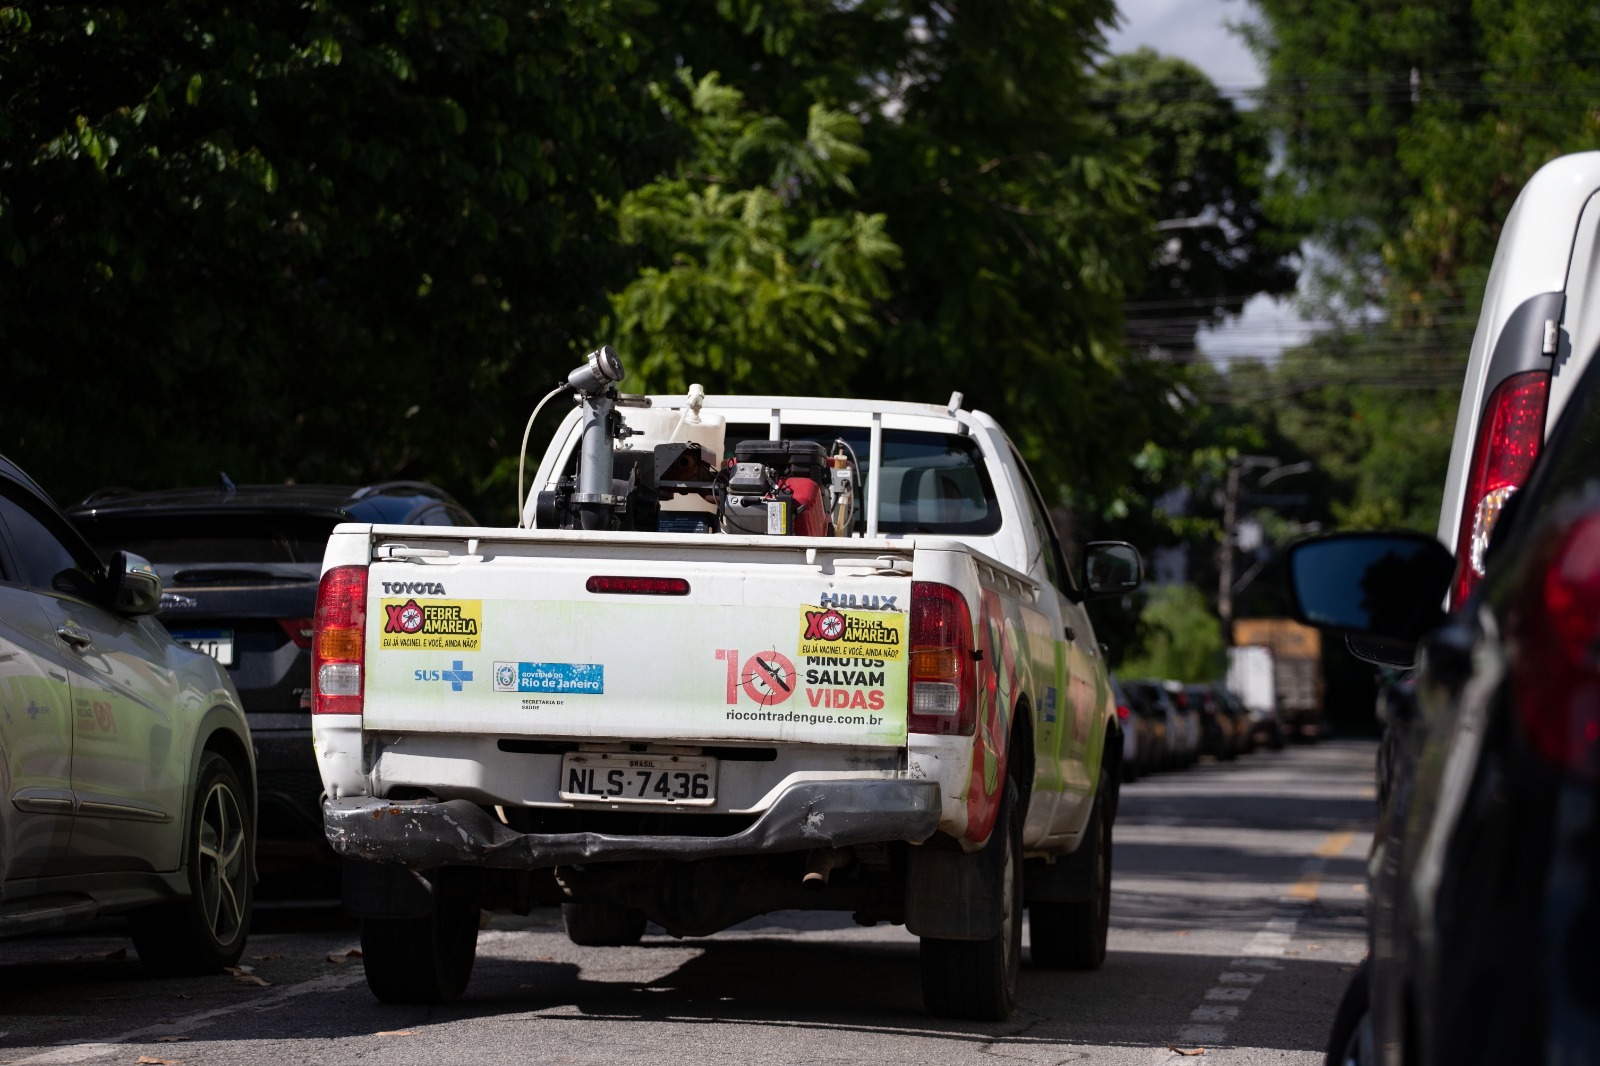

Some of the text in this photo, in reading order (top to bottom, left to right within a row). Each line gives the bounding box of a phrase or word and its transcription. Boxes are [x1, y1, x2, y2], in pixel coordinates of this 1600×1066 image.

[382, 582, 446, 595] TOYOTA
[820, 592, 898, 611] HILUX
[424, 607, 460, 620] FEBRE
[423, 620, 476, 633] AMARELA
[845, 616, 882, 629] FEBRE
[383, 638, 392, 647] EU
[392, 636, 399, 647] JÁ
[445, 640, 461, 648] AINDA
[462, 638, 478, 648] NÃO?
[844, 628, 897, 643] AMARELA
[802, 645, 811, 654] EU
[811, 643, 818, 652] JÁ
[865, 648, 882, 657] AINDA
[883, 648, 899, 658] NÃO?
[806, 656, 885, 668] MINUTOS
[414, 669, 440, 681] SUS
[715, 649, 796, 706] 10
[806, 670, 884, 686] SALVAM
[522, 678, 599, 689] Rio de Janeiro
[806, 688, 884, 711] VIDAS
[726, 710, 883, 726] riocontradengue.com.br
[629, 760, 655, 768] BRASIL
